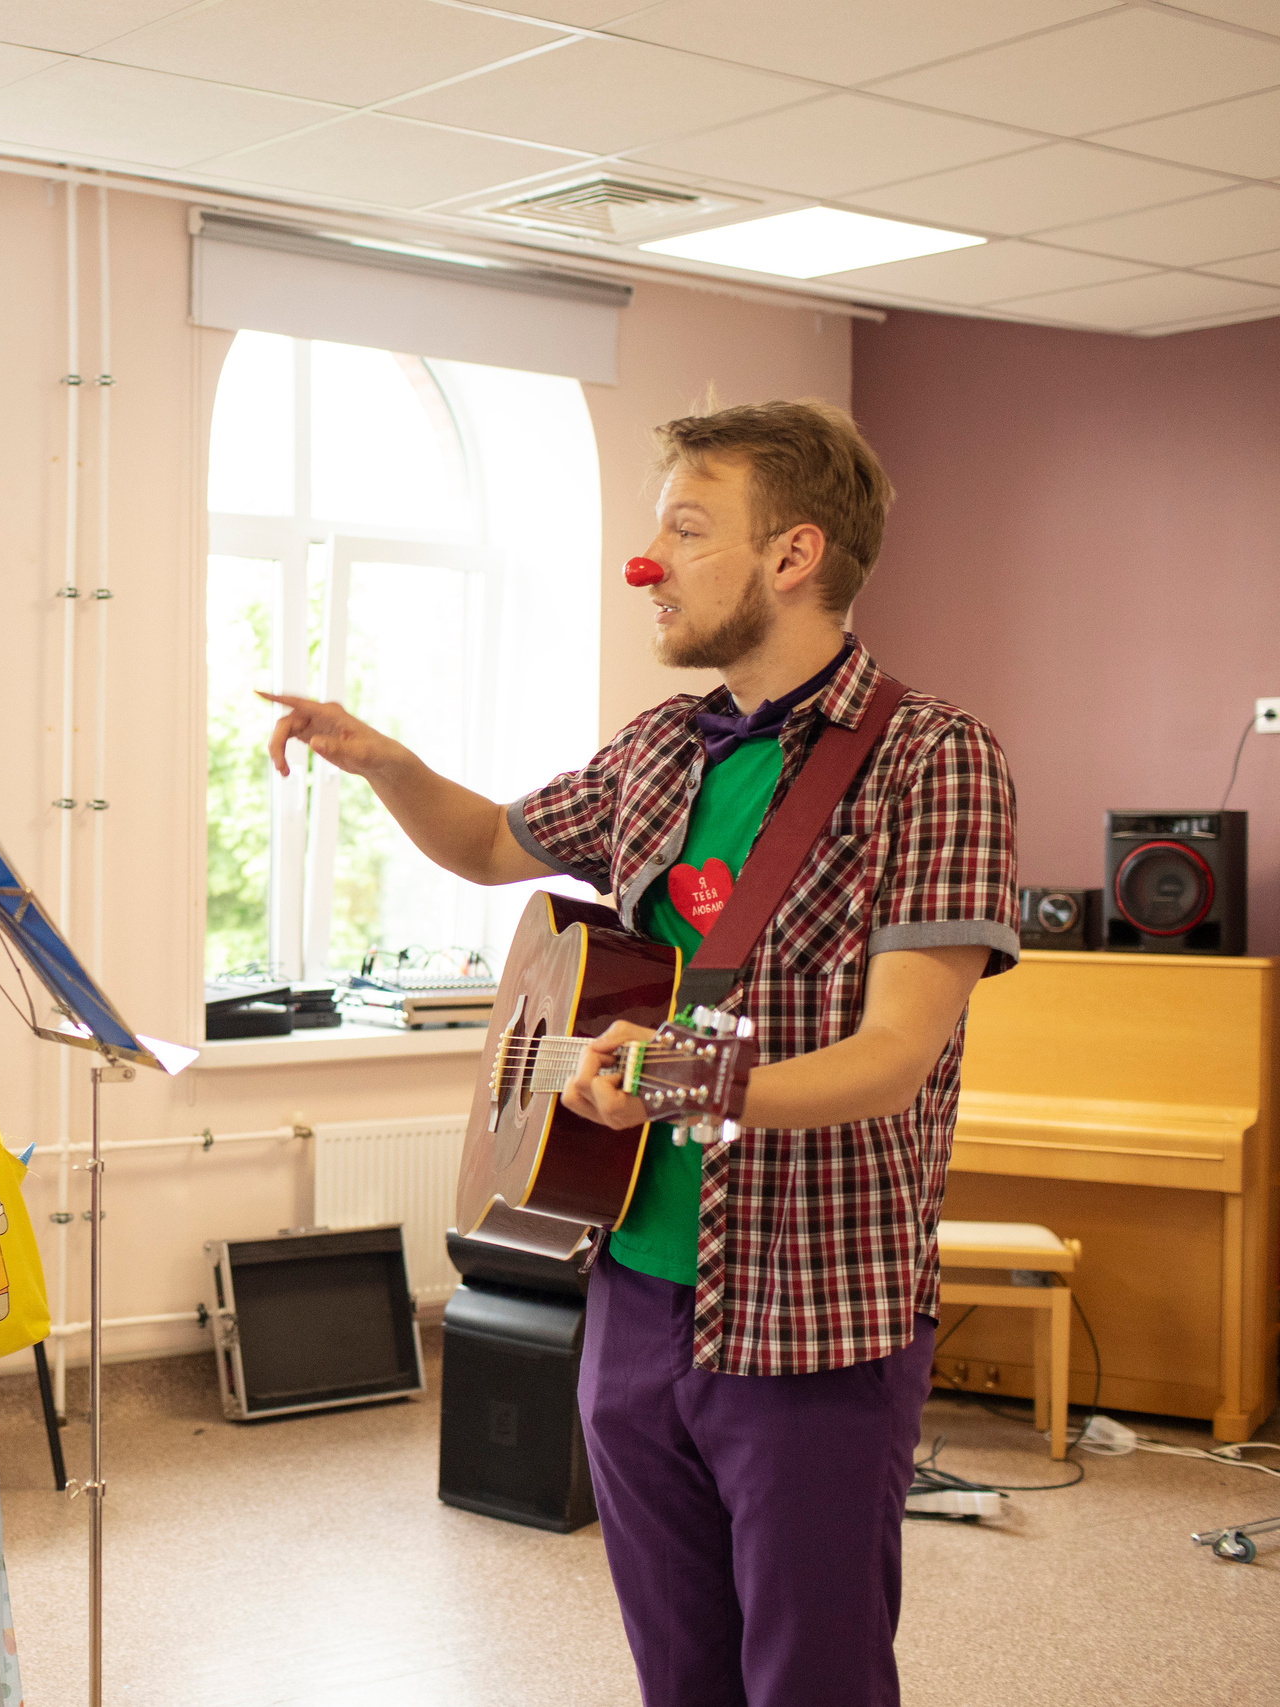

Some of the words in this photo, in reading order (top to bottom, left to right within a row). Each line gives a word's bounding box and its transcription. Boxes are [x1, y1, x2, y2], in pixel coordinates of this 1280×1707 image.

[698, 877, 707, 889] Я
[692, 888, 718, 902] ТЕБЯ
[692, 901, 724, 917] ЛЮБЛЮ
